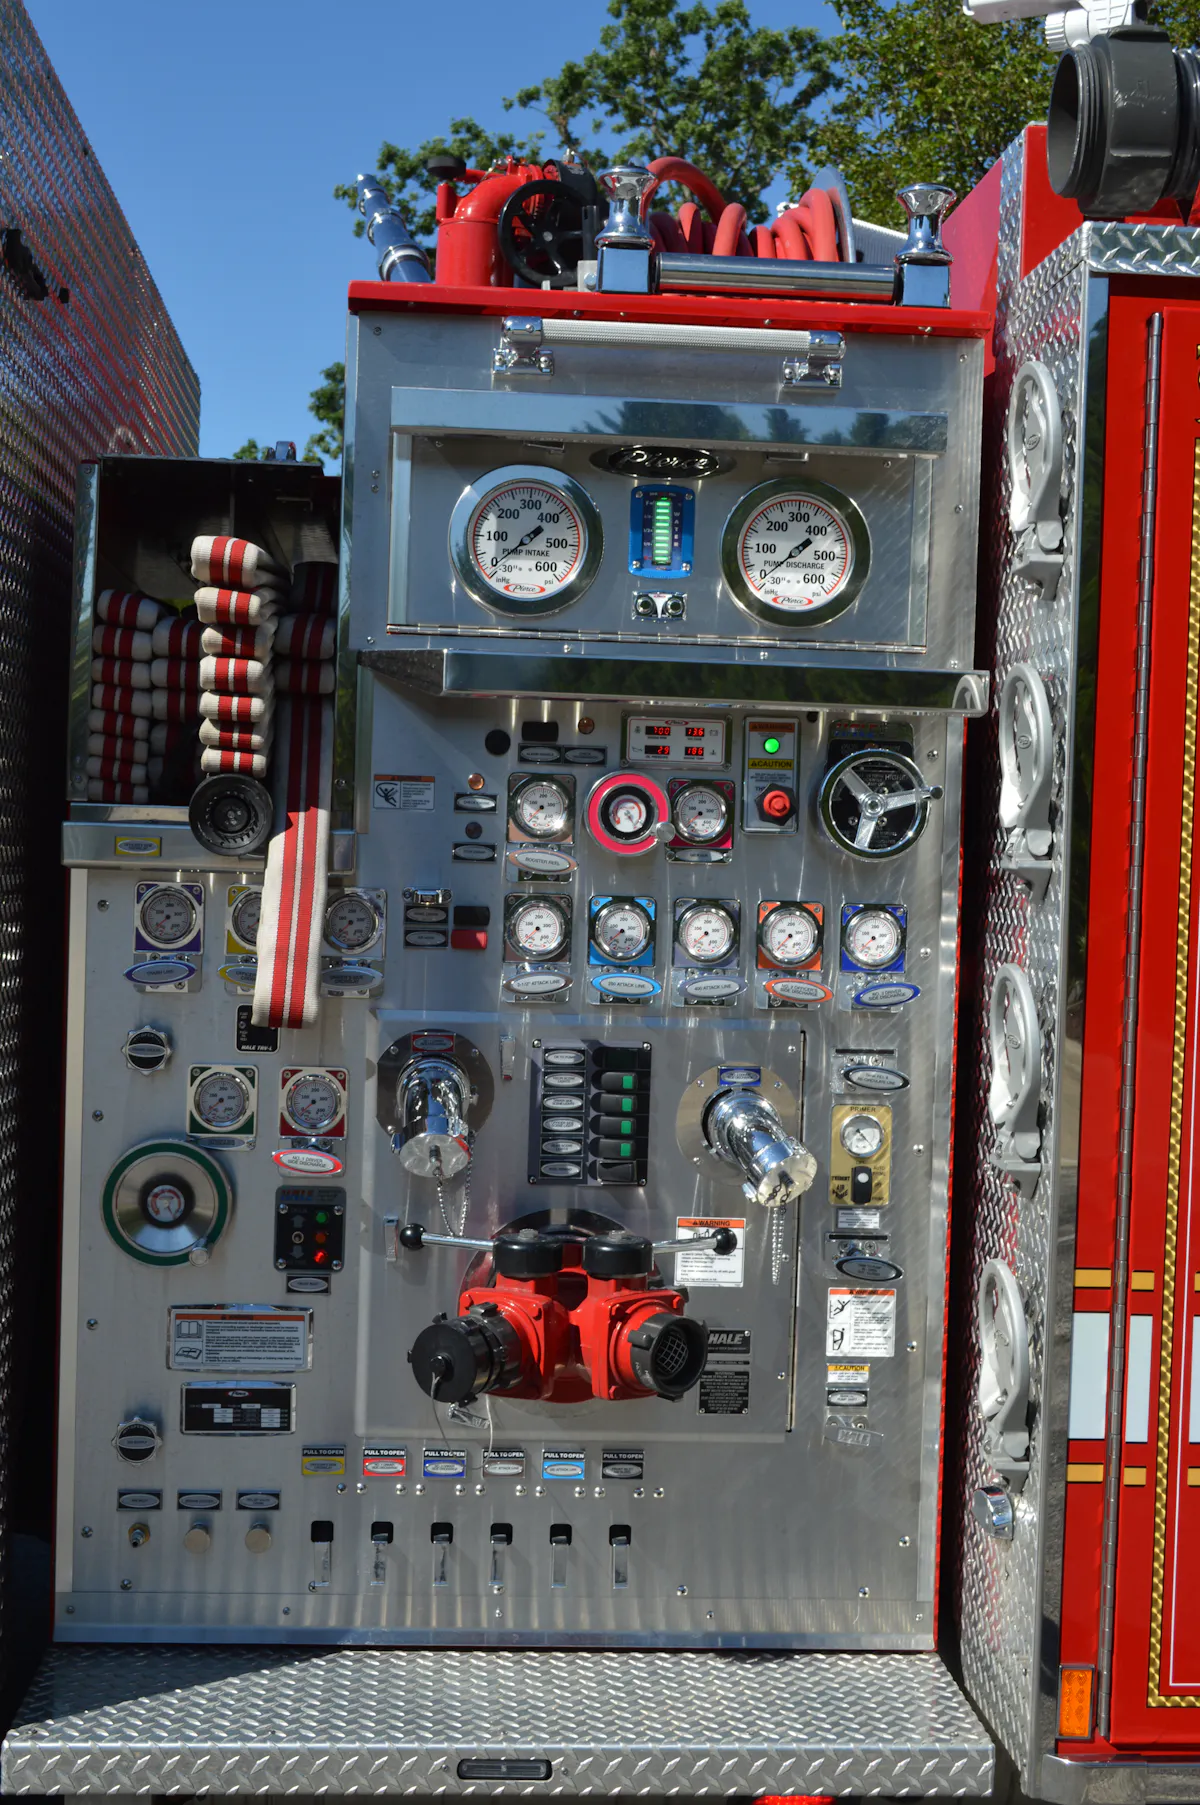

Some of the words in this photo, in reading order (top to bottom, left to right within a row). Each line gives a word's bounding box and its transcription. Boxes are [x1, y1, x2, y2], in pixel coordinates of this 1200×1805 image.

[616, 450, 709, 470] Pierce
[520, 499, 542, 510] 300
[497, 508, 520, 520] 200
[537, 512, 560, 523] 400
[788, 511, 810, 523] 300
[766, 520, 788, 532] 200
[805, 525, 827, 536] 400
[486, 531, 508, 541] 100
[546, 538, 568, 549] 500
[755, 543, 777, 554] 100
[525, 549, 550, 557] INTAKE
[814, 550, 836, 562] 500
[491, 557, 498, 567] 0
[535, 561, 557, 572] 600
[763, 559, 783, 568] PUMP
[786, 561, 825, 570] DISCHARGE
[759, 568, 767, 580] 0
[803, 573, 825, 585] 600
[495, 576, 510, 584] inHg
[544, 578, 554, 586] psi
[512, 584, 536, 592] Pierce
[781, 595, 804, 604] Pierce
[657, 746, 669, 754] 29
[687, 747, 703, 756] 186
[757, 760, 792, 768] CAUTION
[791, 988, 818, 997] DISCHARGE
[880, 992, 906, 1000] DISCHARGE
[299, 1160, 327, 1168] DISCHARGE
[708, 1333, 744, 1345] HALE
